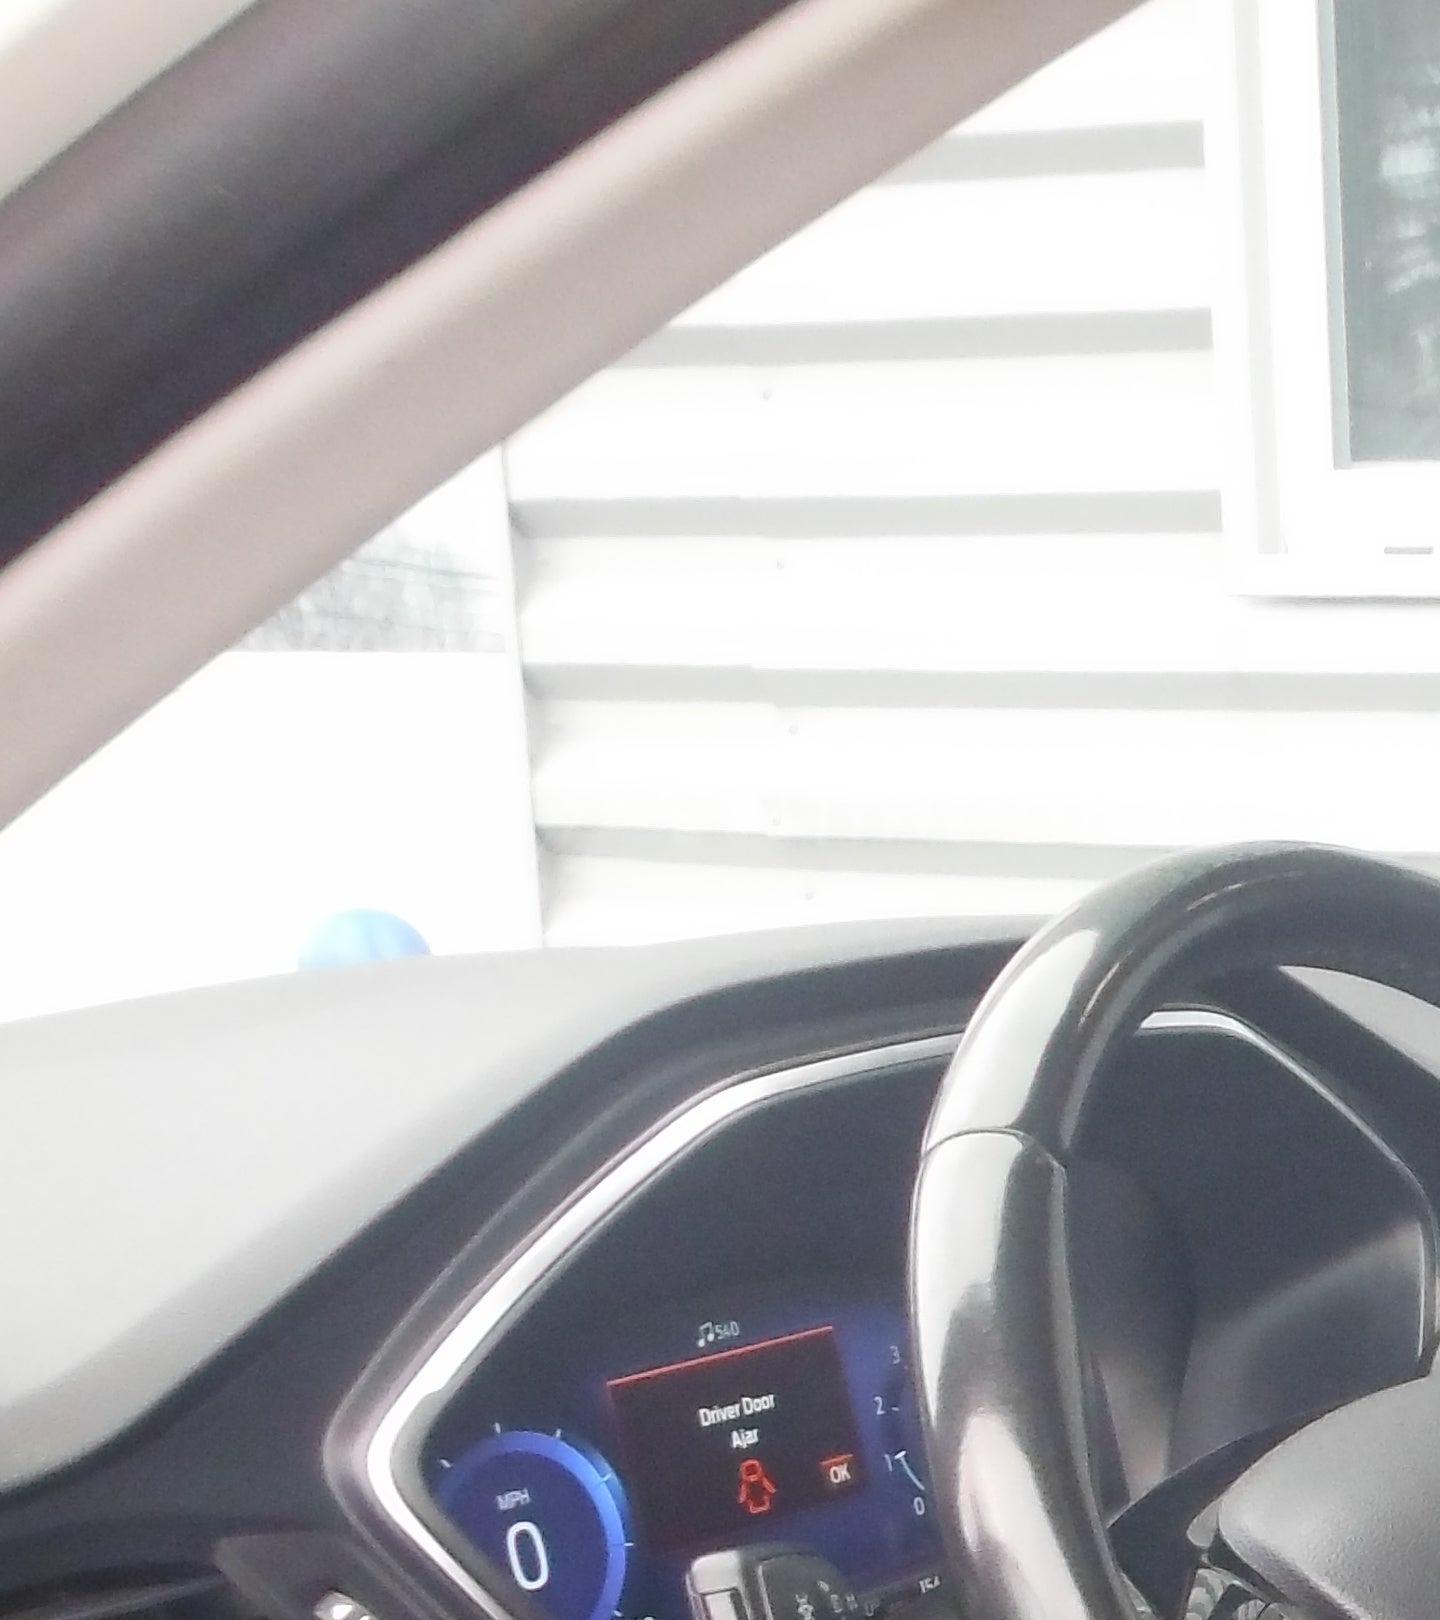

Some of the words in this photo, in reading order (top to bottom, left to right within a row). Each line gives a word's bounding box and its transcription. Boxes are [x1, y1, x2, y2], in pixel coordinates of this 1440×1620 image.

[700, 1402, 741, 1427] Driver
[742, 1392, 775, 1416] Door
[731, 1428, 759, 1449] Ajar
[829, 1463, 851, 1484] OK
[507, 1521, 549, 1590] 0
